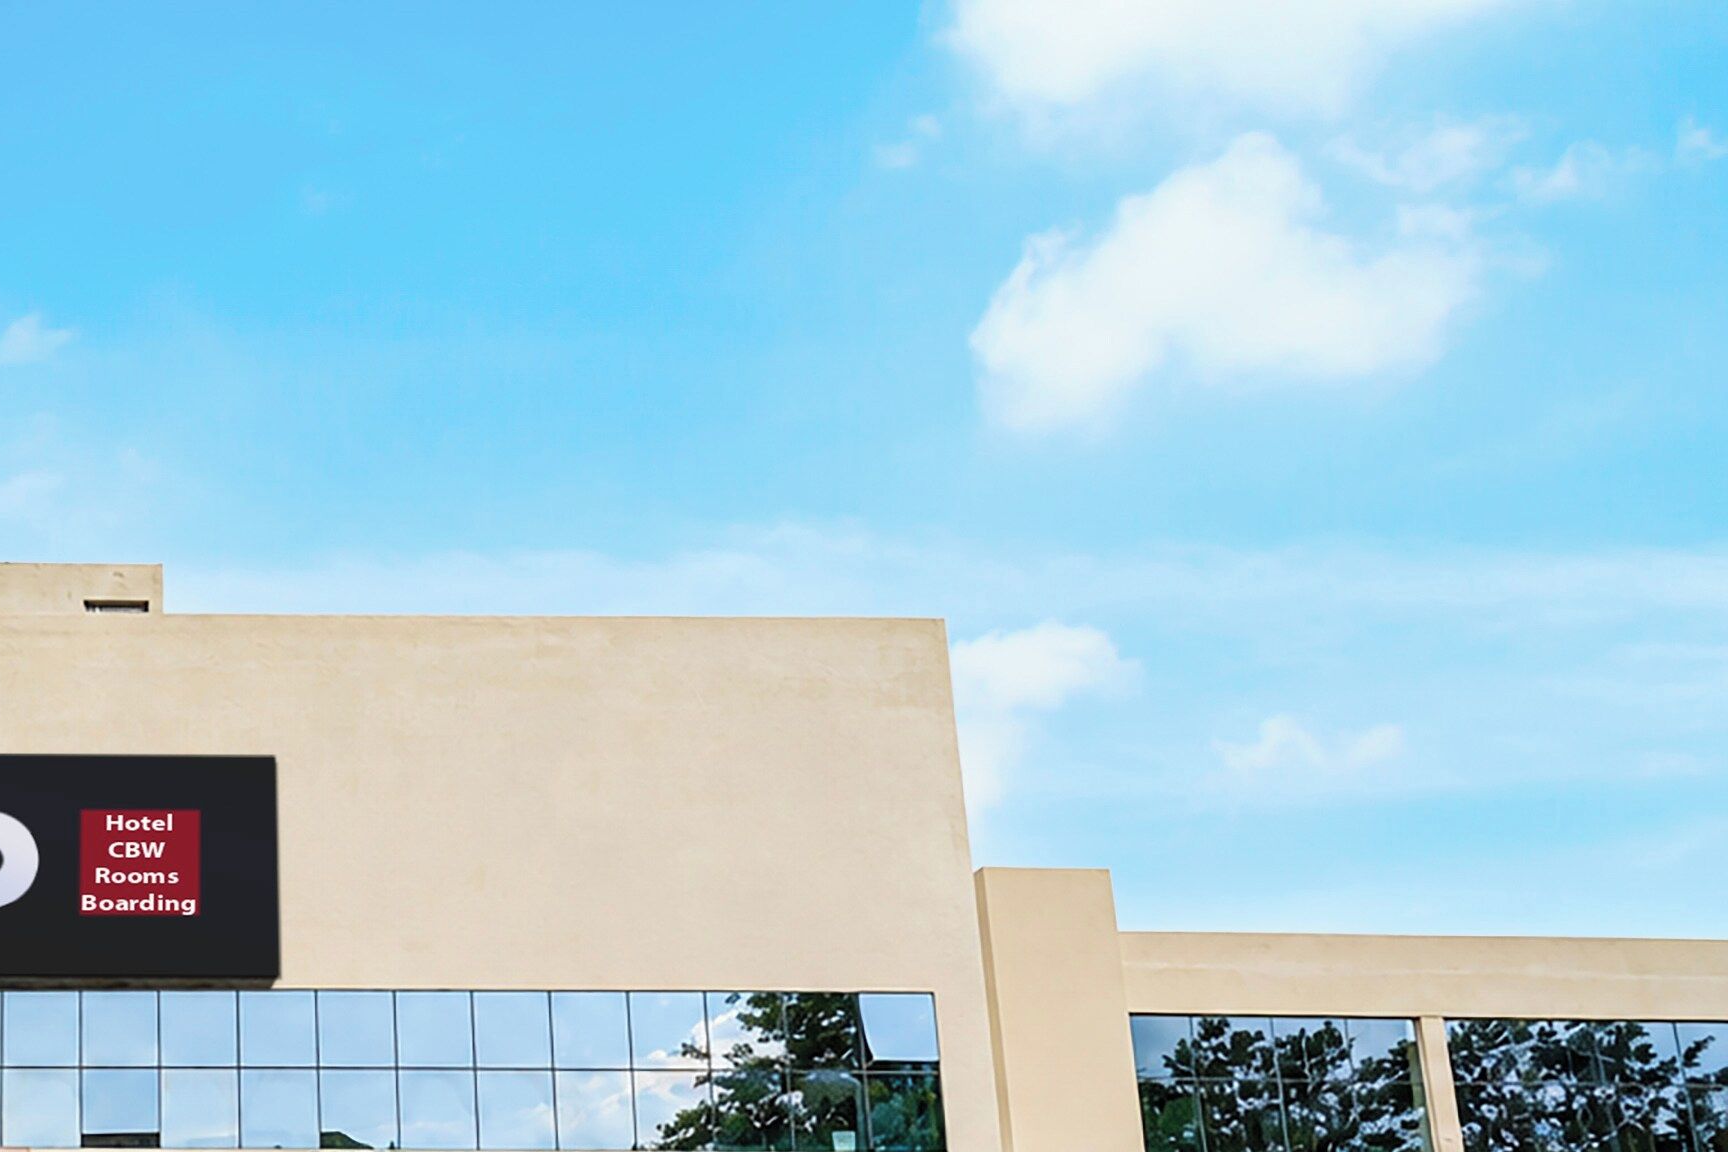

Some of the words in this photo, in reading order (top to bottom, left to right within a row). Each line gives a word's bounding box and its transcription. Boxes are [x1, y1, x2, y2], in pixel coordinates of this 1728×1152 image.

[106, 814, 173, 831] Hotel
[108, 841, 166, 859] CBW
[95, 867, 180, 885] Rooms
[81, 894, 197, 916] Boarding
